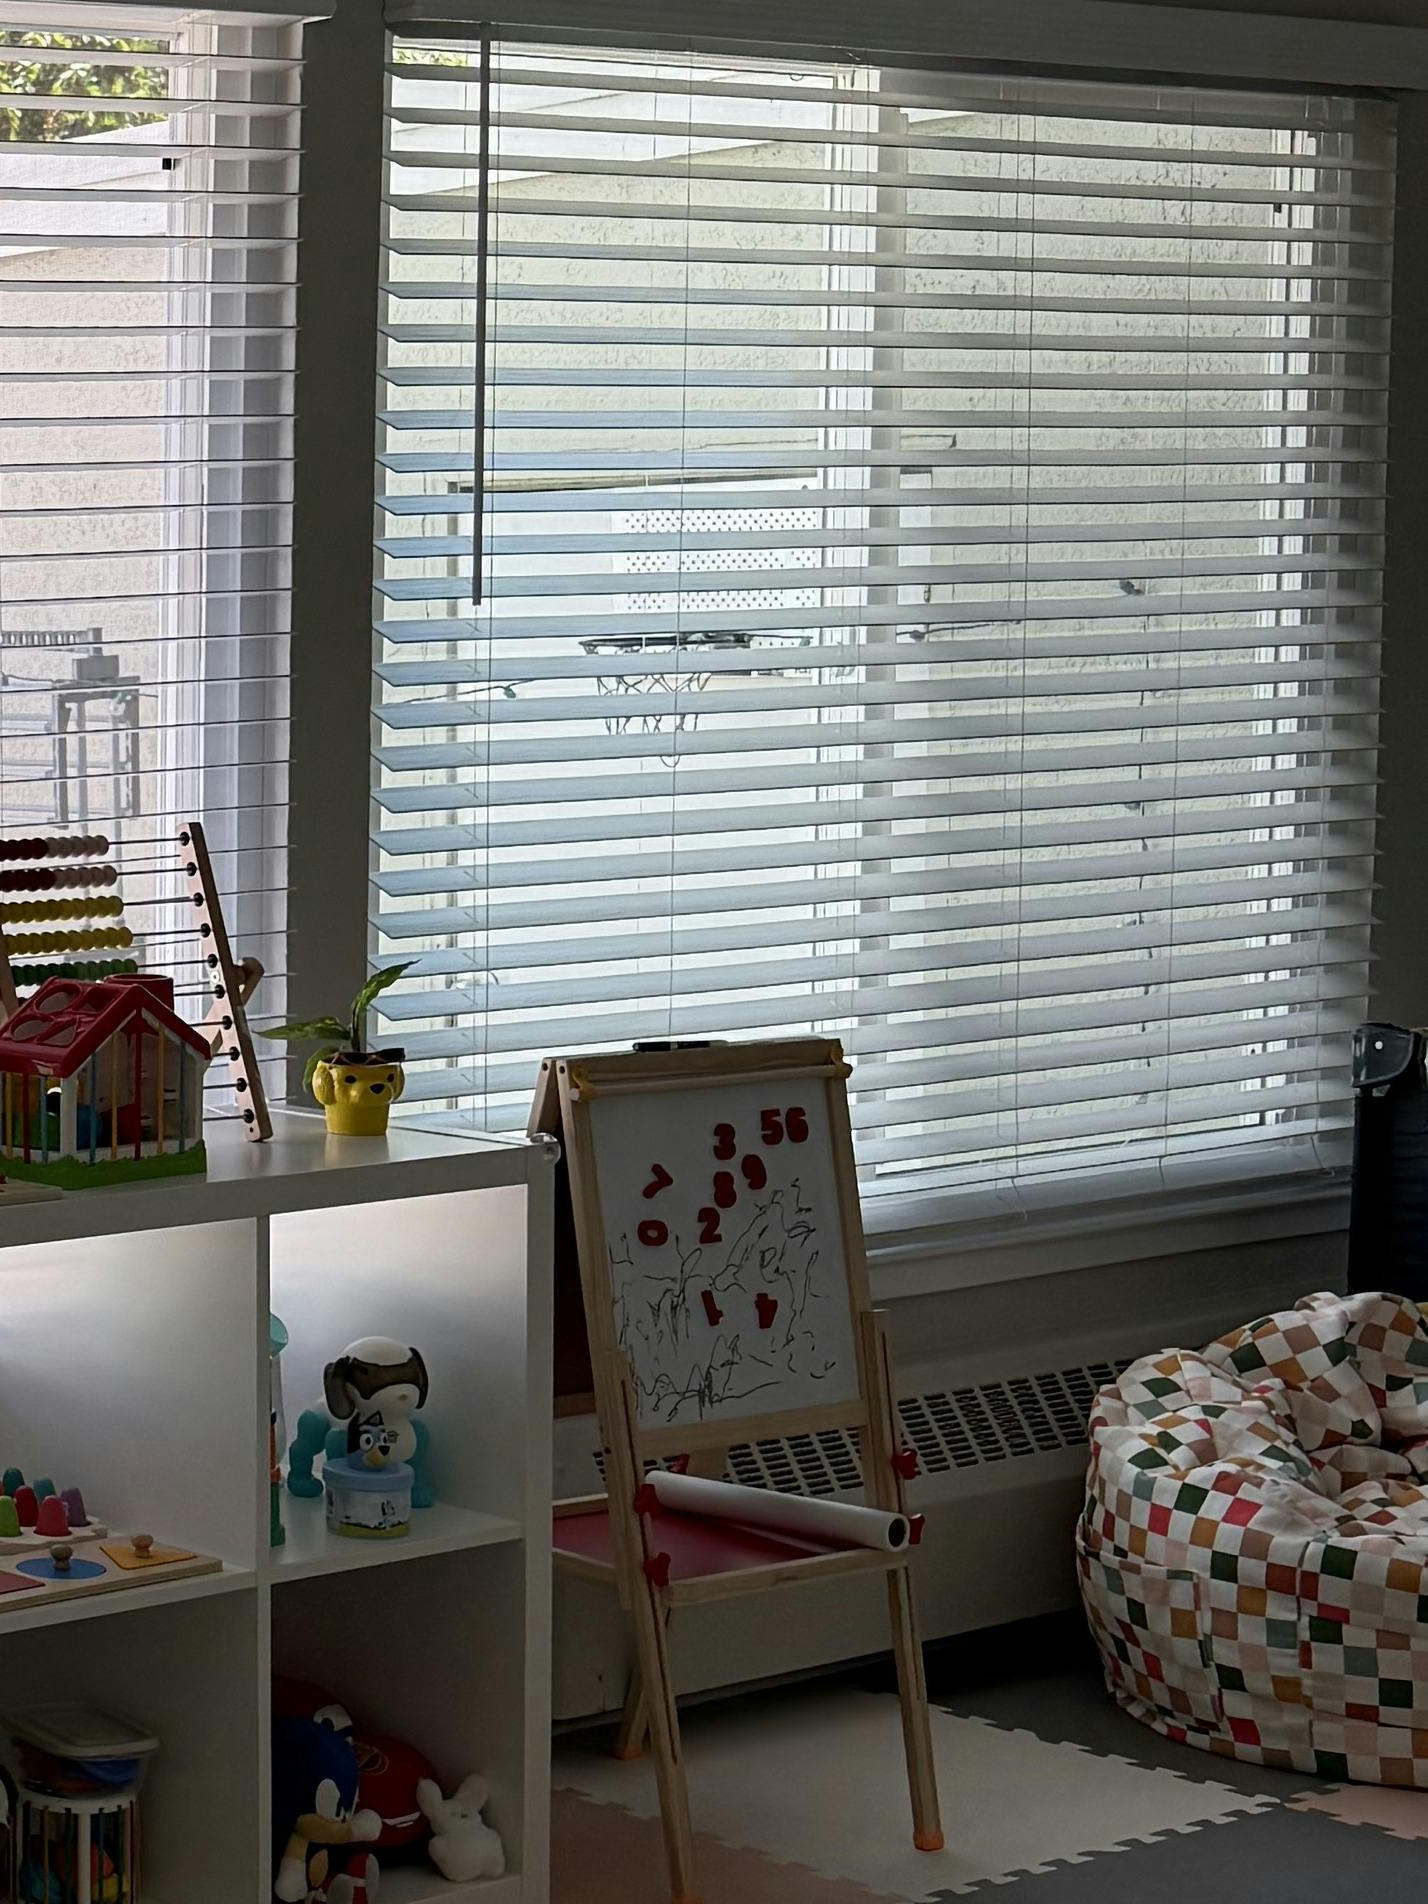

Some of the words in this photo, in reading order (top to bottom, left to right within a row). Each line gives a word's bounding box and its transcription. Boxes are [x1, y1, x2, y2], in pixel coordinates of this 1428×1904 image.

[713, 1123, 736, 1160] 3
[714, 1171, 736, 1208] 8
[742, 1154, 767, 1189] 9
[697, 1207, 722, 1244] 2
[755, 1293, 777, 1329] 4
